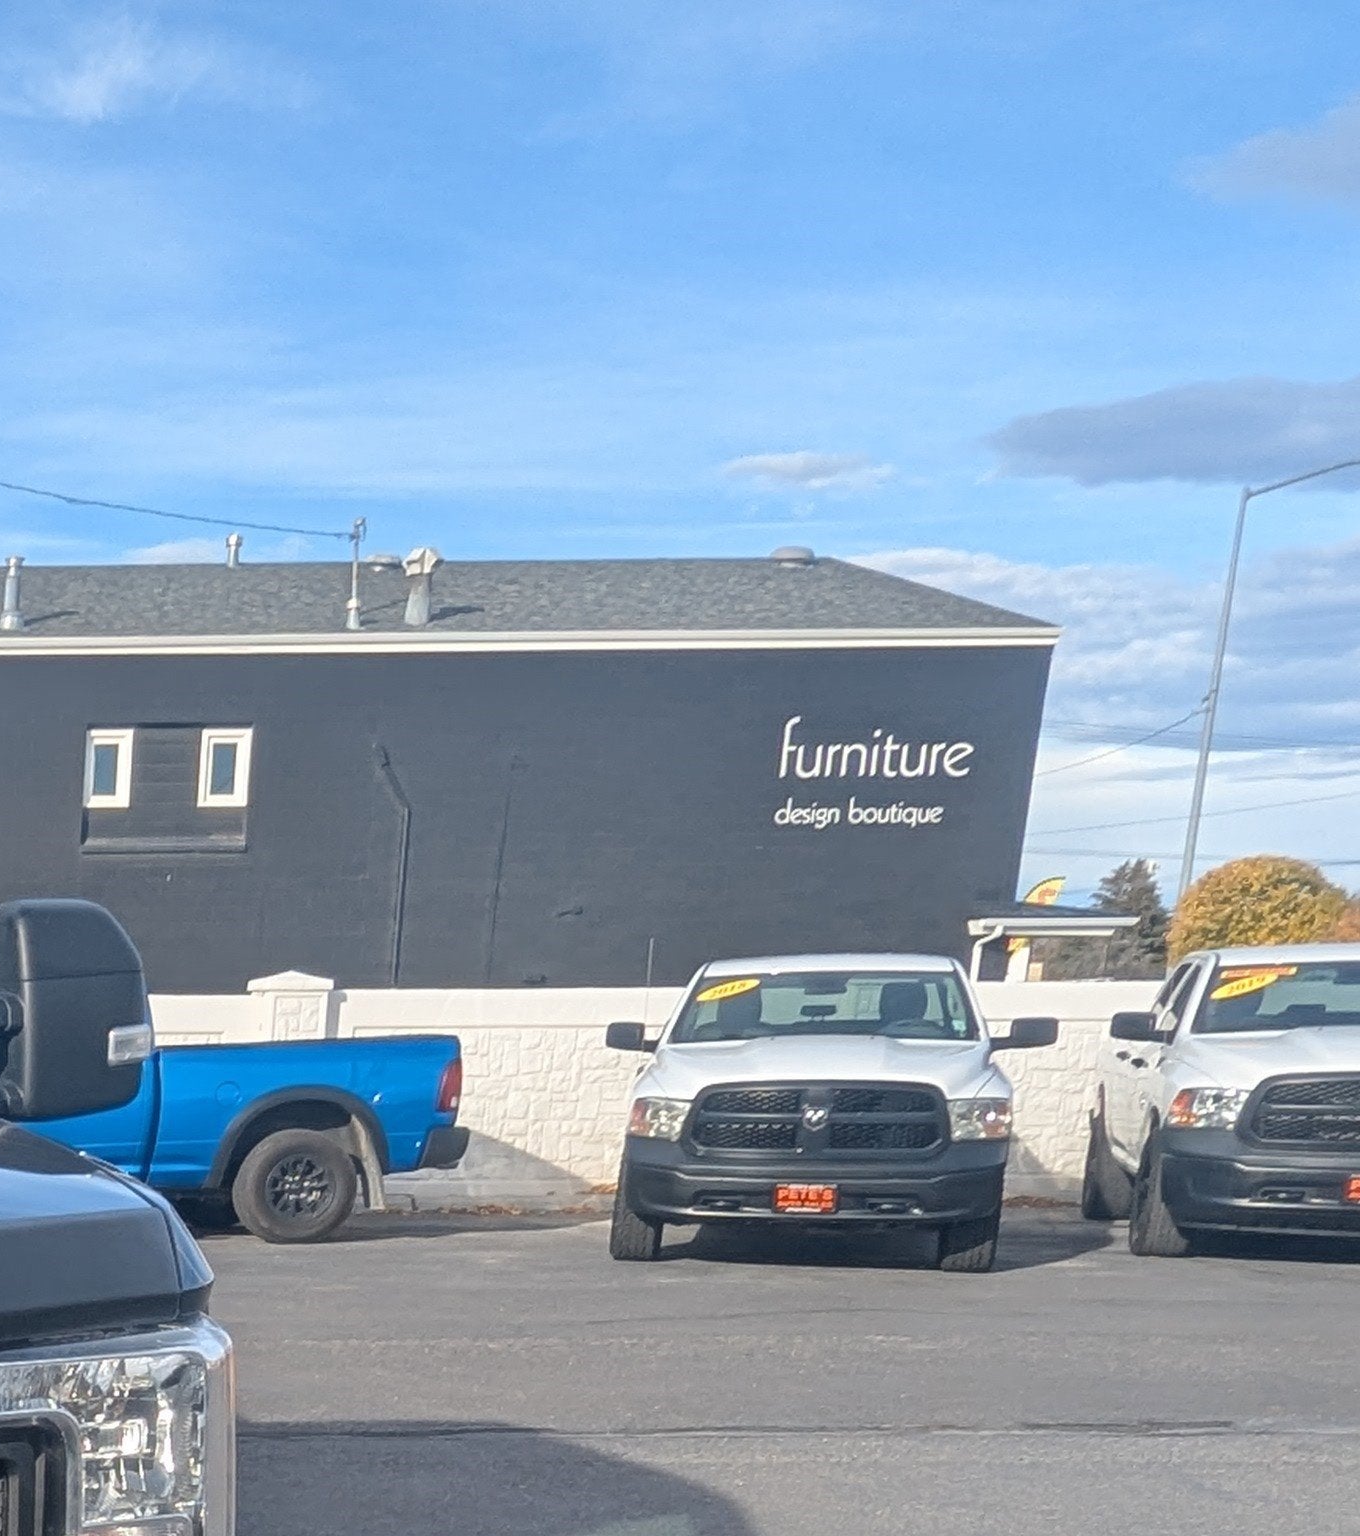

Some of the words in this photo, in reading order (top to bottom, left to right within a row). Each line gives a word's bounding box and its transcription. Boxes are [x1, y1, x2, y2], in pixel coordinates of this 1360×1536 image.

[777, 715, 975, 779] furniture
[773, 797, 840, 829] design
[847, 796, 945, 828] boutique
